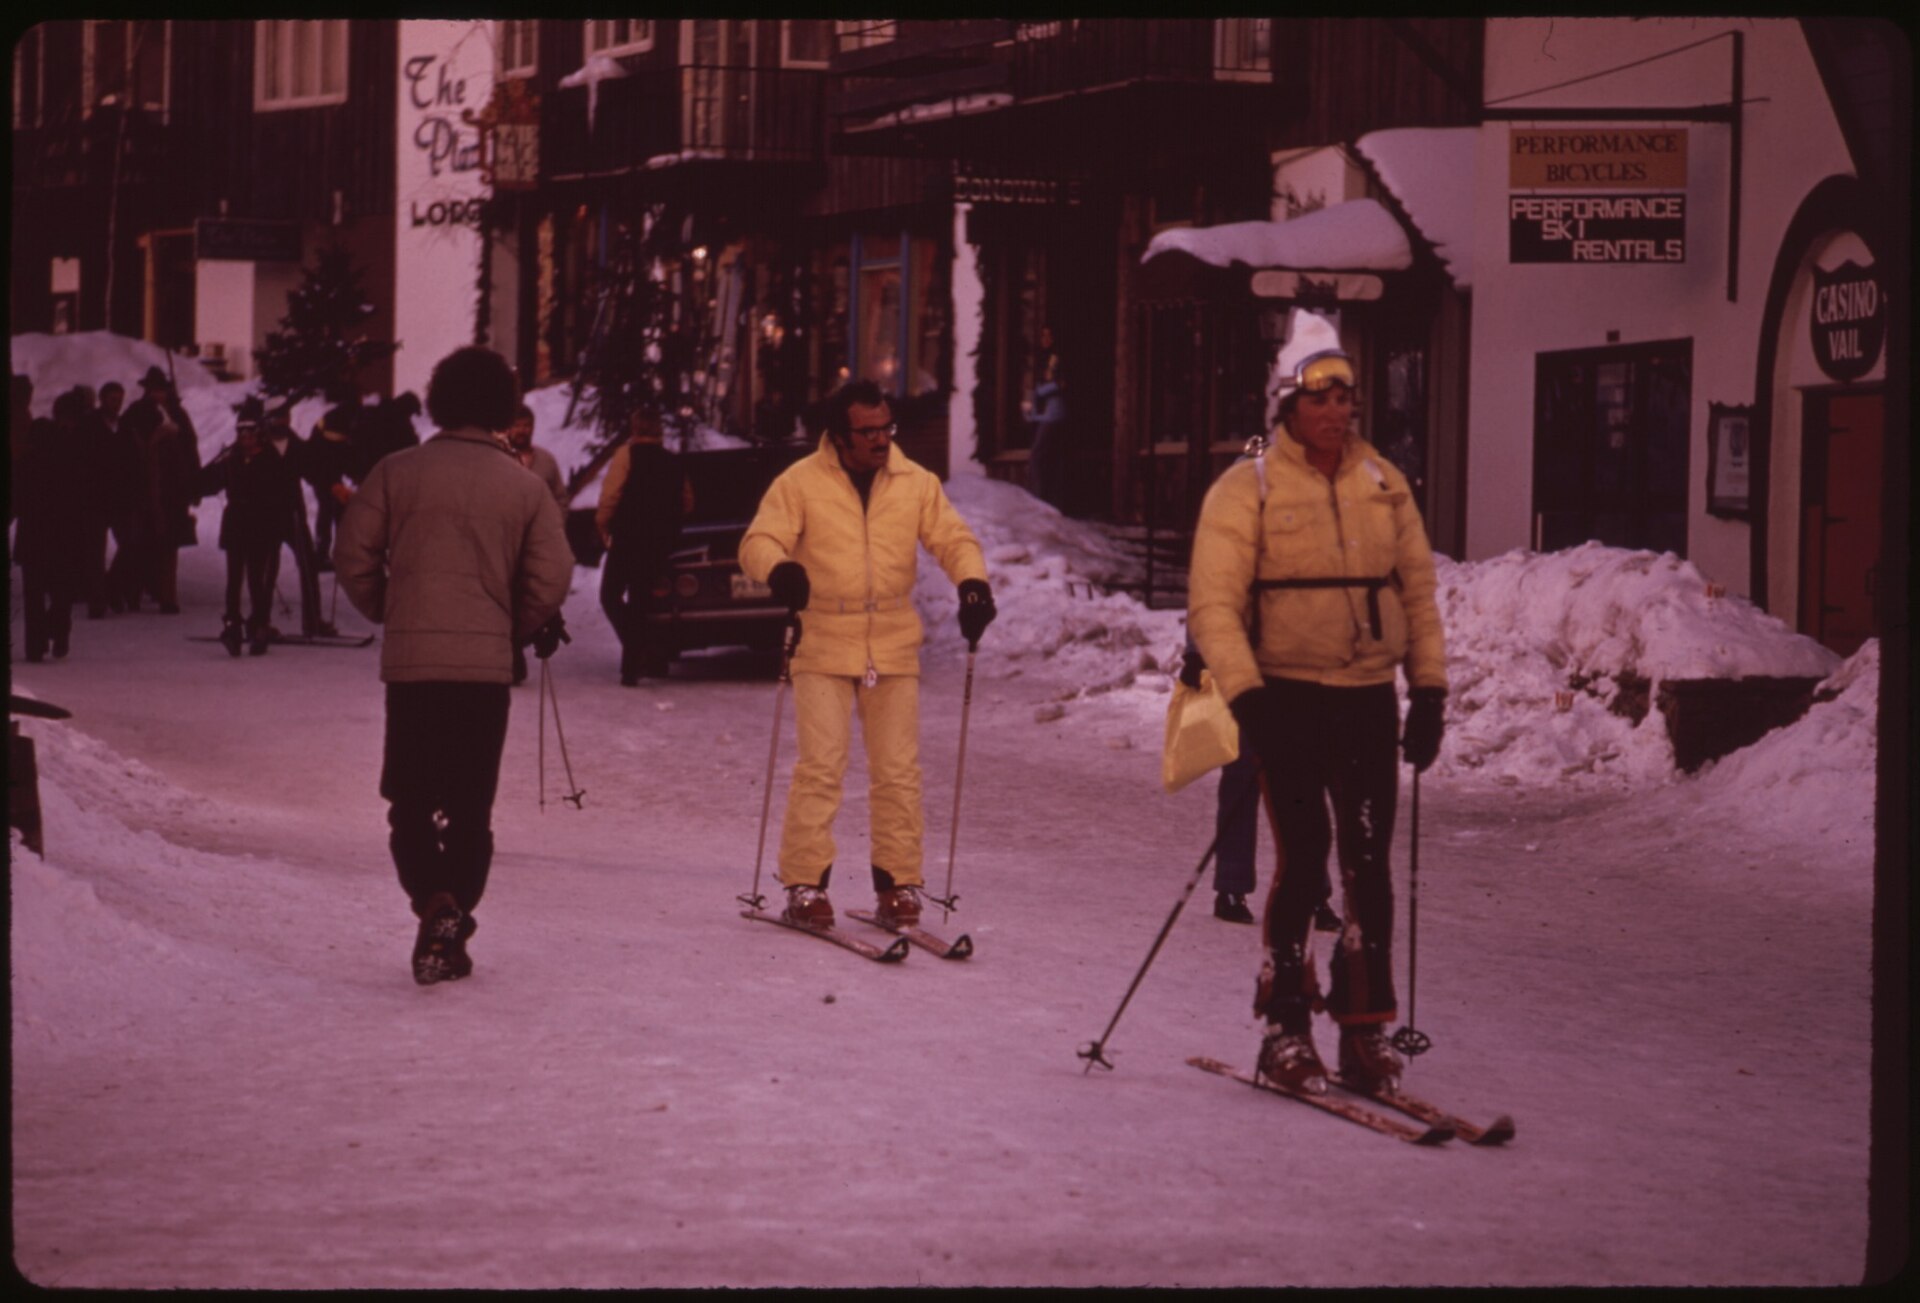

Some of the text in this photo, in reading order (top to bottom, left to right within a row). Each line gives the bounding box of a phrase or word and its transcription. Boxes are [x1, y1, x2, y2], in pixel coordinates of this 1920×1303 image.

[405, 54, 466, 109] The
[1514, 133, 1678, 154] PERFORMANCE
[1545, 162, 1647, 182] BICYCLES
[411, 198, 484, 227] LODG
[1511, 197, 1682, 219] PERFORMANCE
[1541, 219, 1585, 240] SKI
[1573, 240, 1682, 260] RENTALS
[1816, 279, 1878, 324] CASINO
[1828, 328, 1863, 361] VAIL
